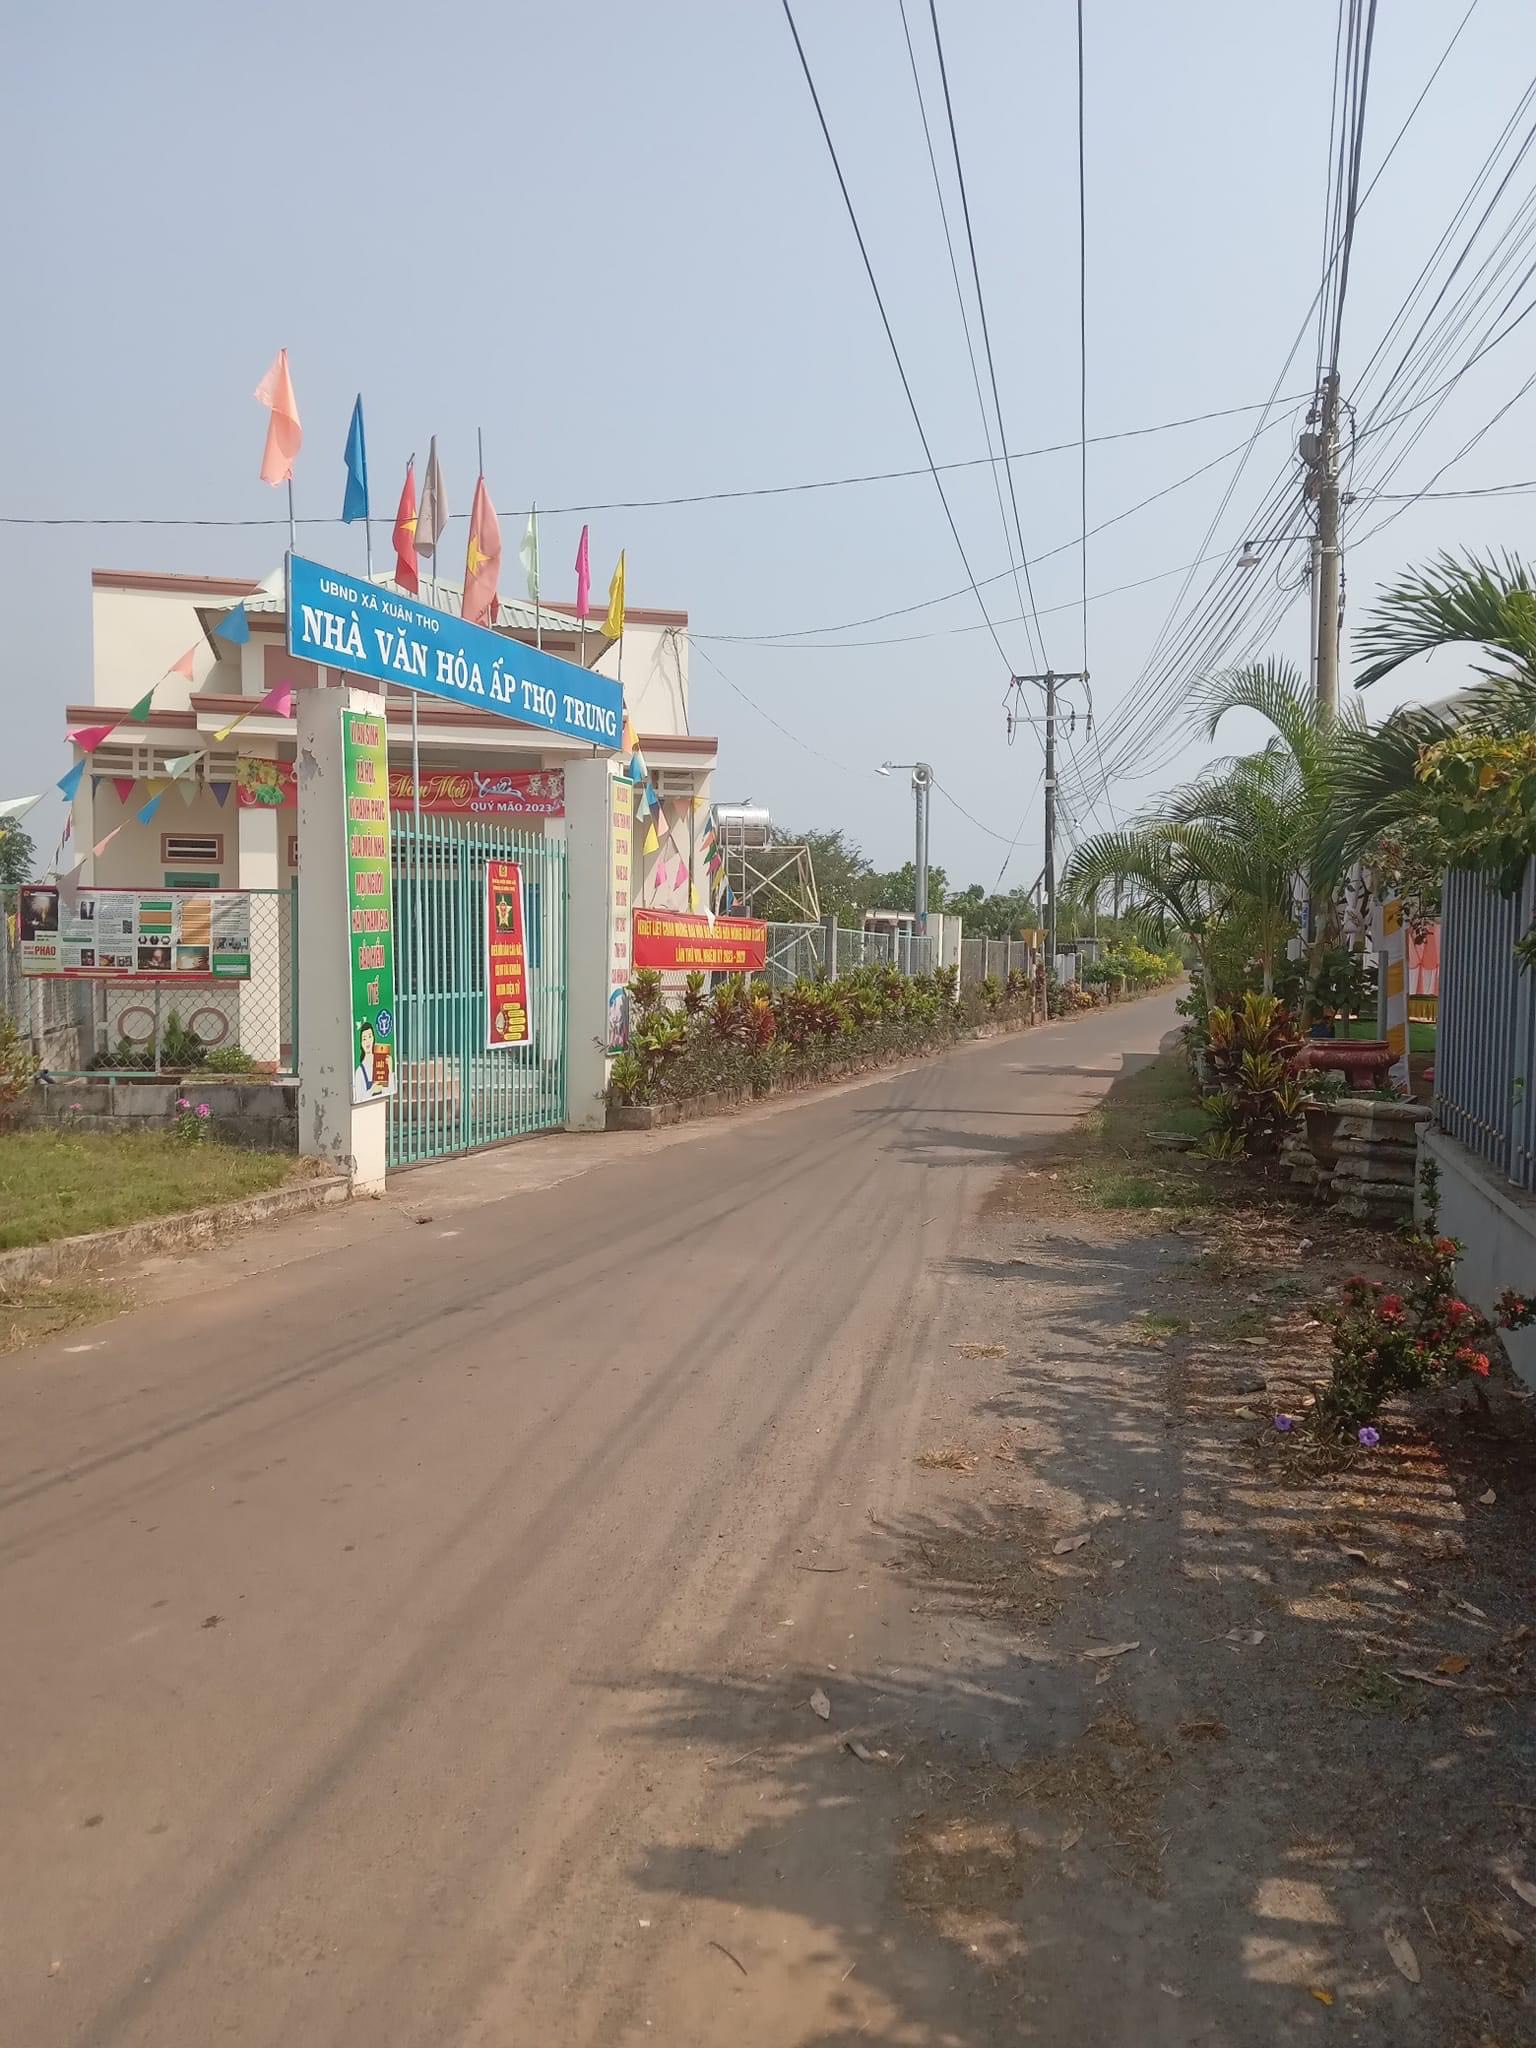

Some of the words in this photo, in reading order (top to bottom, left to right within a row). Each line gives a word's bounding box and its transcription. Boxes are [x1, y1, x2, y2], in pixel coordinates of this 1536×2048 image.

[320, 577, 358, 603] UBND
[361, 592, 379, 613] XÃ
[381, 599, 414, 623] XUÂN
[416, 613, 440, 635] THỌ
[301, 603, 367, 660] NHÀ
[374, 626, 429, 678] VĂN
[435, 647, 485, 695] HÓA
[489, 656, 517, 704] ẤP
[521, 679, 557, 725] THỌ
[563, 694, 617, 737] TRUNG
[357, 722, 365, 745] AN
[365, 723, 380, 746] SINH
[356, 755, 364, 782] XÃ
[356, 797, 370, 825] HẠNH
[371, 796, 385, 820] PHÚC
[470, 800, 494, 812] QUÝ
[497, 800, 522, 812] MÃO
[525, 803, 552, 812] 2023
[351, 827, 362, 857] CỦA
[363, 829, 373, 857] MỖI
[356, 872, 367, 901] MỌI
[367, 867, 384, 896] NGƯỜI
[352, 905, 363, 933] HÃY
[364, 910, 379, 932] THAM
[380, 909, 390, 932] GIA
[359, 939, 370, 970] BẢO
[371, 936, 385, 968] HIỂM
[372, 975, 380, 1004] TẾ
